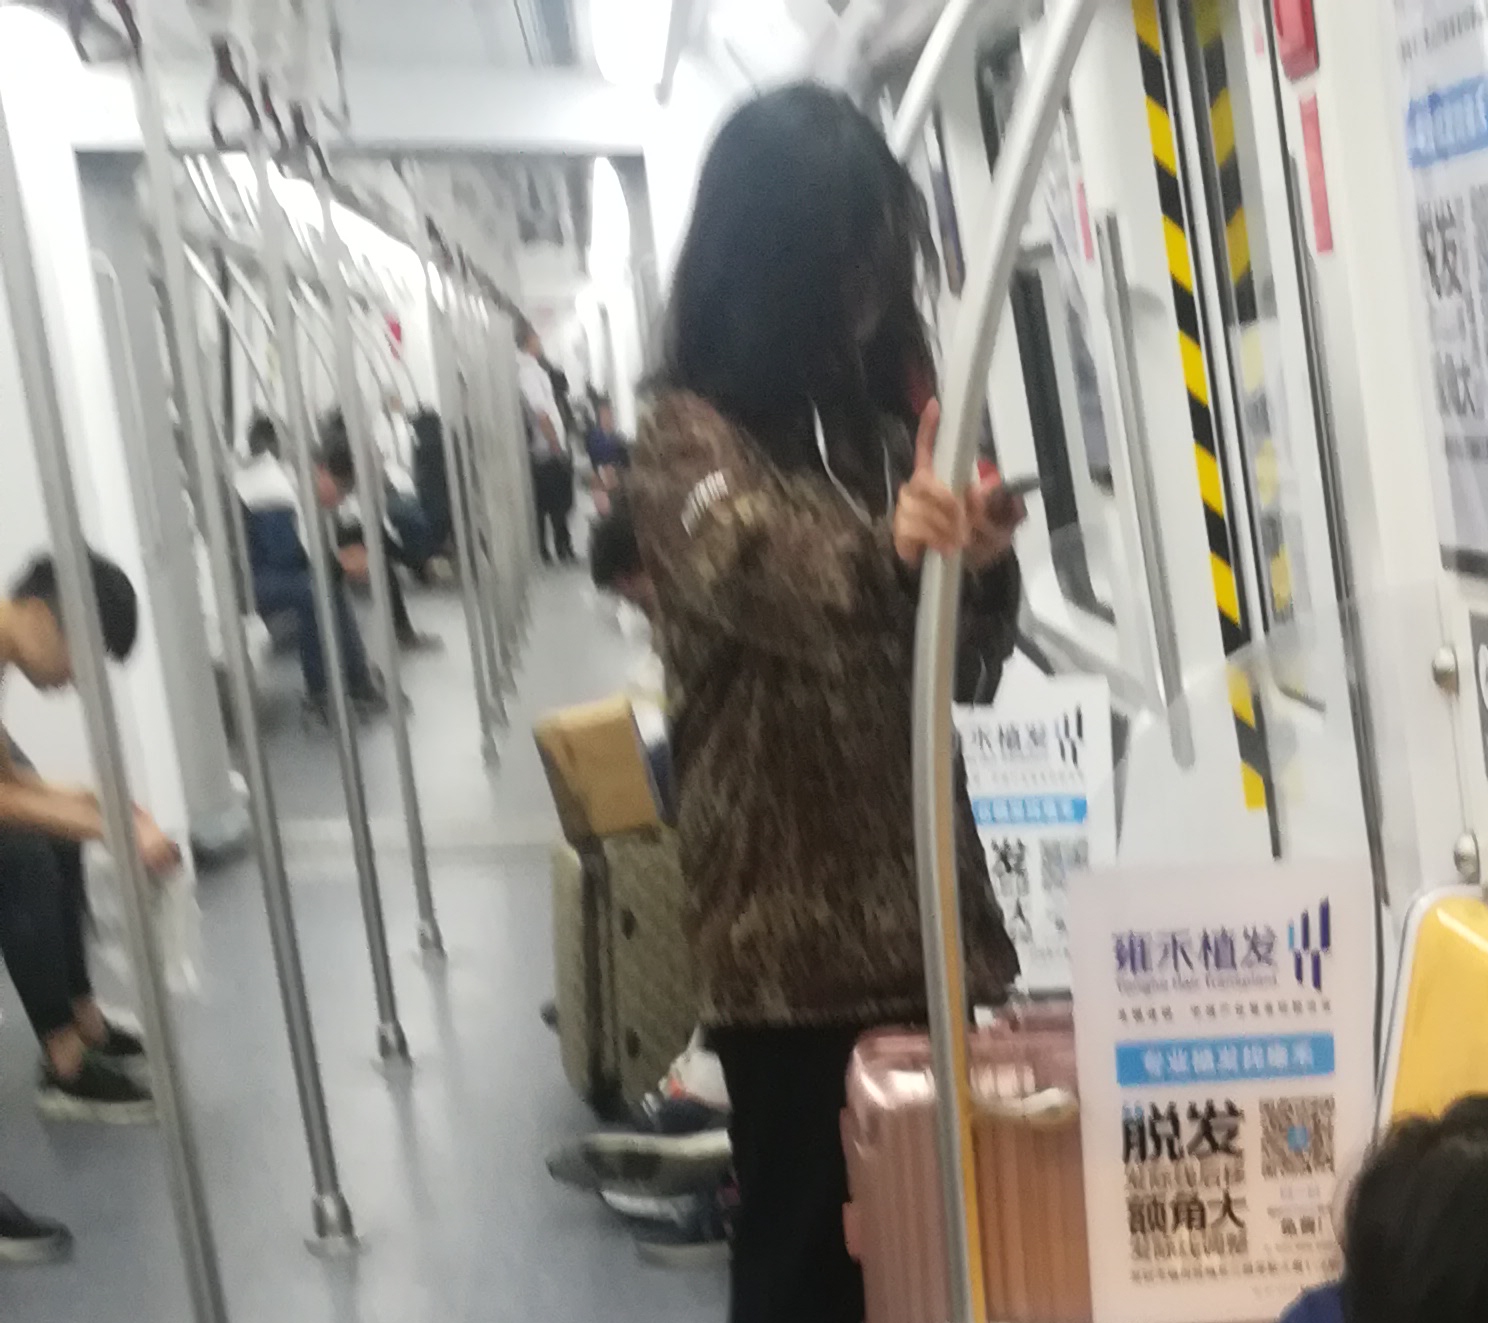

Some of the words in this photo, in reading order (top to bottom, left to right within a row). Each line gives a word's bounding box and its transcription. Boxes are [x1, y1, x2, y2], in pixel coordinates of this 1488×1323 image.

[1113, 926, 1277, 974] 雍禾植发
[1122, 1098, 1245, 1164] 脱发
